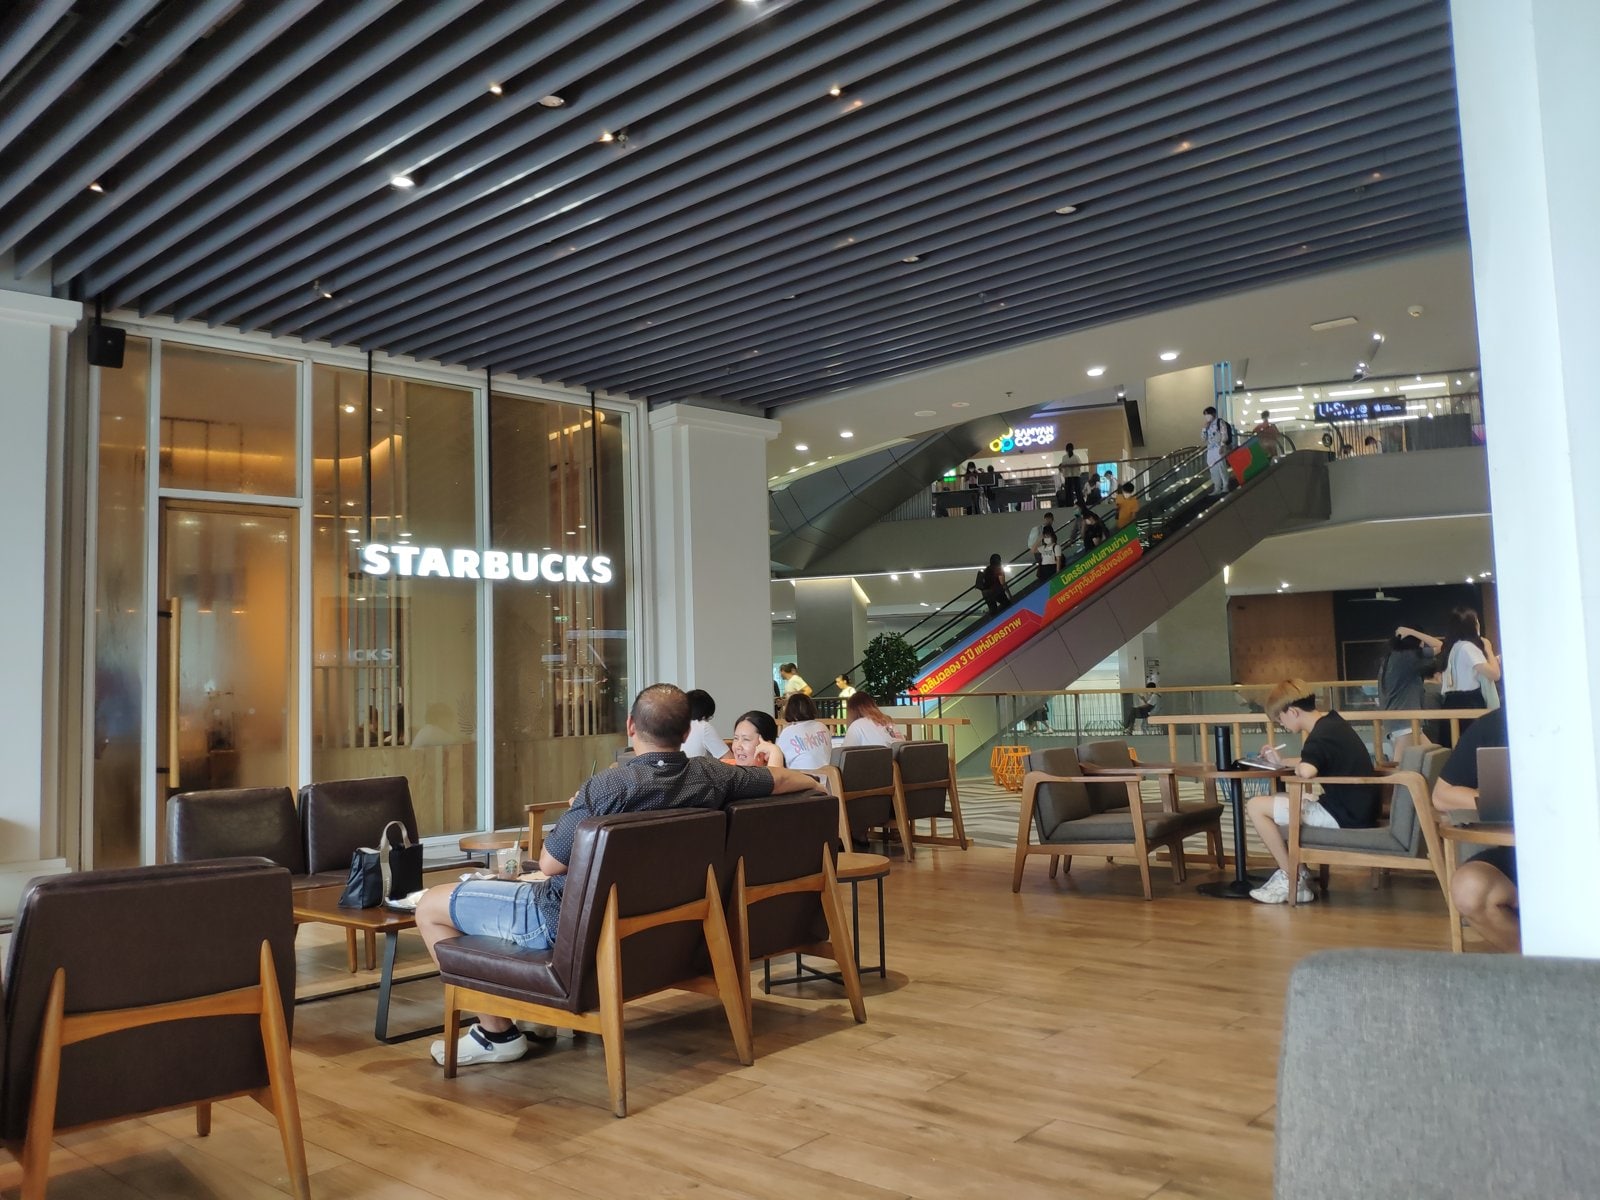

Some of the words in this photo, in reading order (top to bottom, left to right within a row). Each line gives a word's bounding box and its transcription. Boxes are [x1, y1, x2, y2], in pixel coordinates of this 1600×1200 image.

[1014, 434, 1055, 447] CO-OP
[362, 543, 613, 584] STARBUCKS
[960, 655, 968, 665] 3
